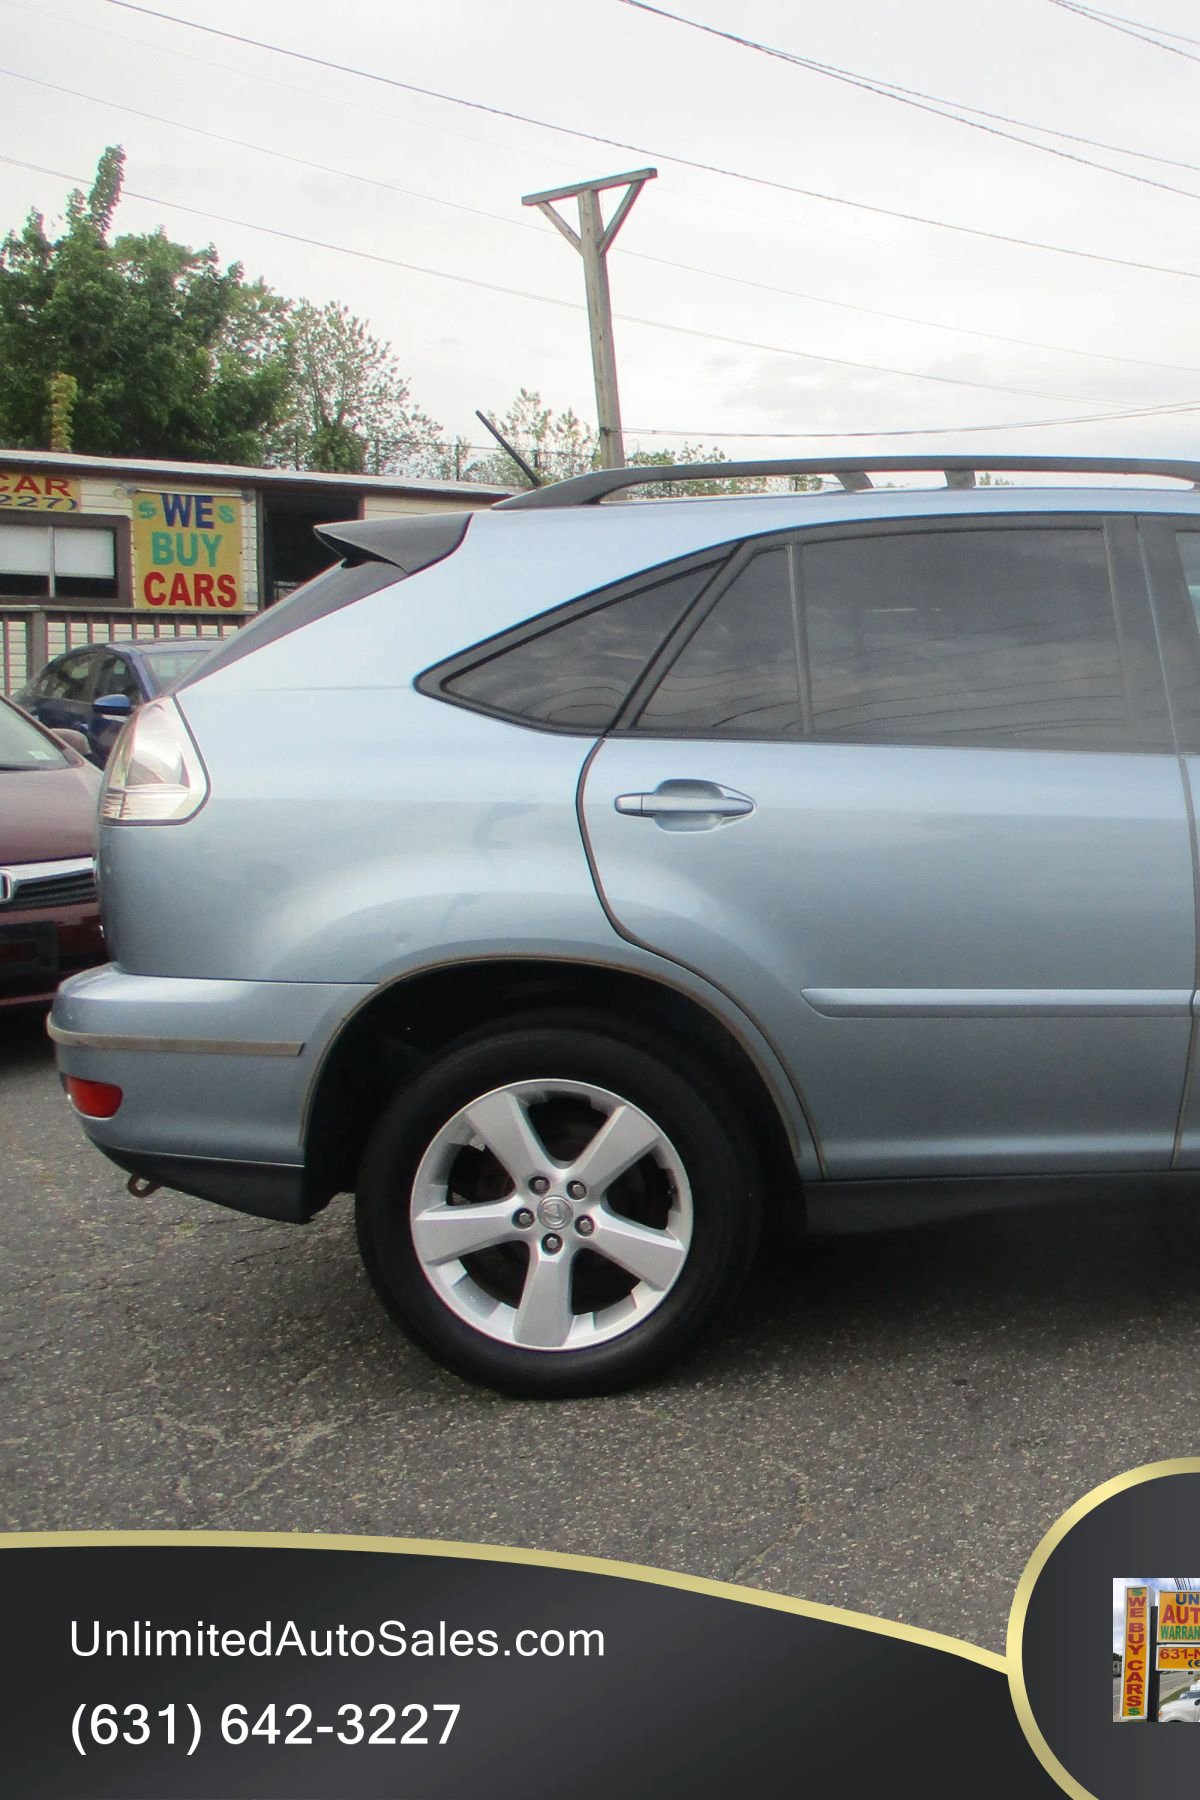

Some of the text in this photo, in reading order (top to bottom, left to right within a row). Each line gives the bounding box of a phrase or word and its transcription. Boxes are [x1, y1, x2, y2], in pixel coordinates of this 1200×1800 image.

[159, 493, 215, 529] WE
[152, 531, 222, 567] BUY
[143, 571, 237, 608] CARS
